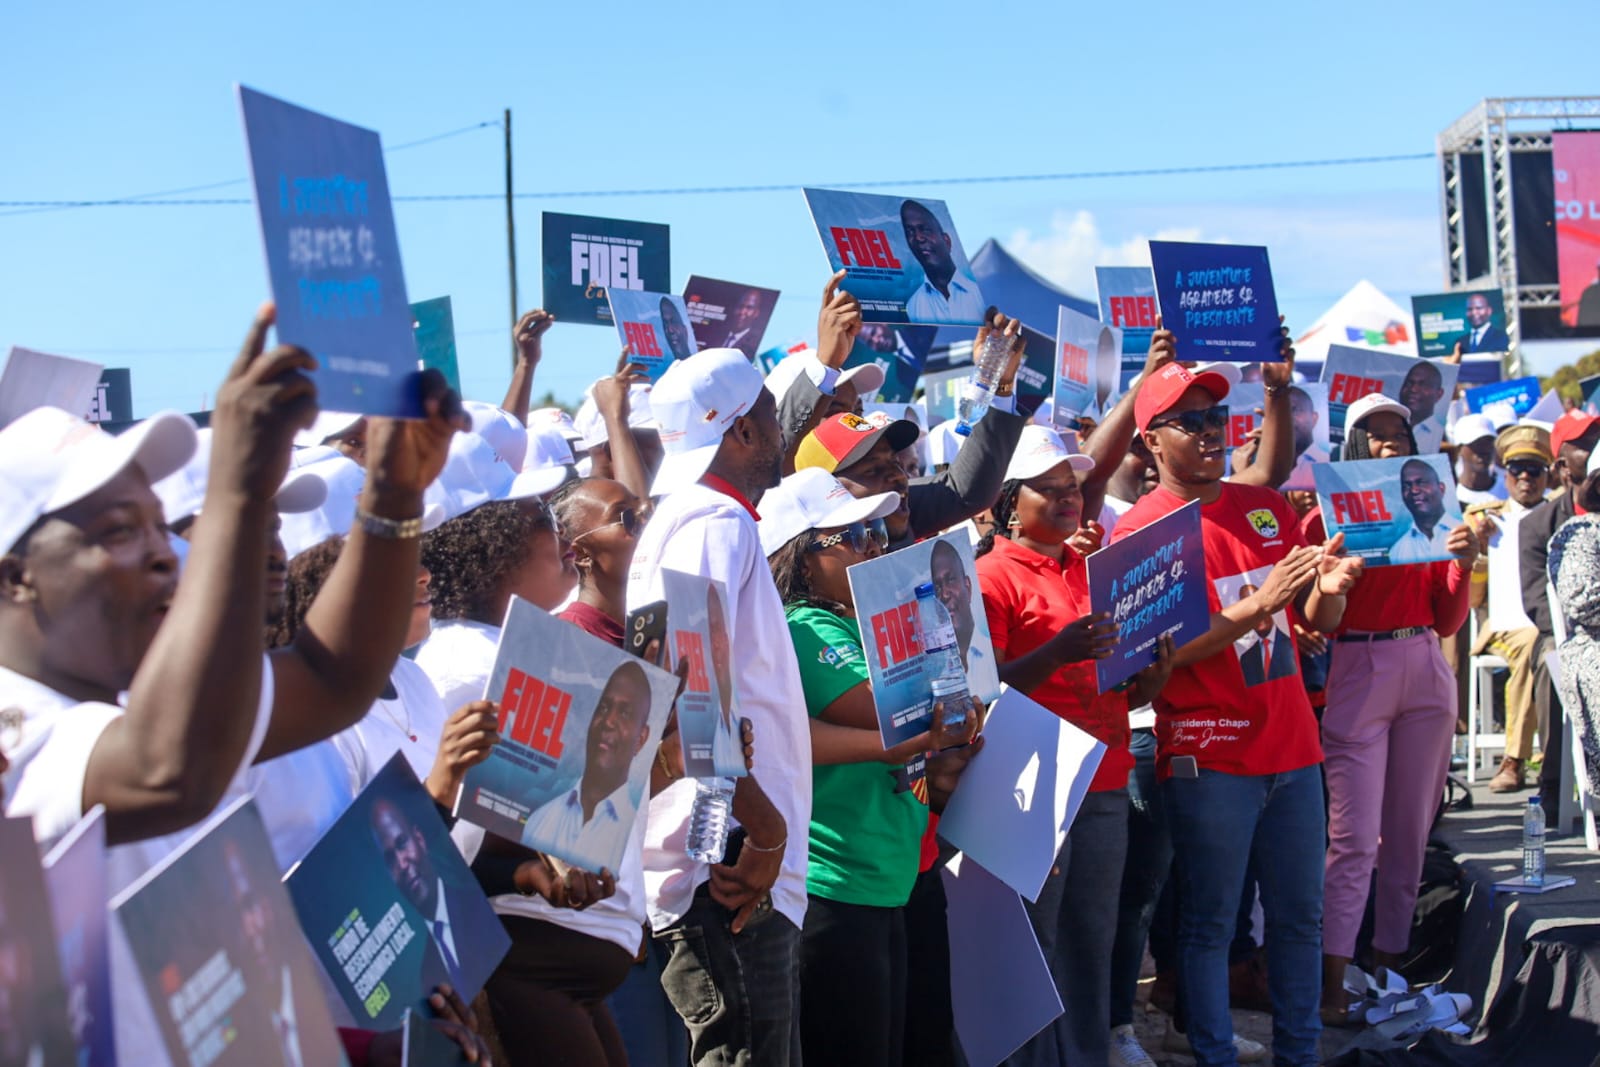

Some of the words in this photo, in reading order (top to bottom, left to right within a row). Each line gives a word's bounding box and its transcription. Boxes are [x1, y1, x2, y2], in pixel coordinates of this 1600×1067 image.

[571, 240, 644, 291] FDEL
[829, 226, 902, 269] FDEL
[1175, 270, 1183, 288] A
[1188, 266, 1252, 287] JUVENTUDE
[1179, 287, 1235, 310] AGRADECE
[1239, 285, 1258, 305] SR.
[623, 321, 664, 357] FDEL
[1185, 306, 1255, 329] PRESIDENTE
[1062, 342, 1088, 385] FDEL
[1330, 489, 1392, 524] FDEL
[1110, 579, 1118, 602] A
[1123, 535, 1184, 592] JUVENTUDE
[1113, 570, 1167, 623] AGRADECE
[1171, 560, 1187, 585] SR.
[1118, 582, 1184, 640] PRESIDENTE
[497, 667, 573, 760] FDEL
[1219, 718, 1250, 729] Chapo
[332, 928, 361, 966] FUNDO
[353, 915, 370, 939] DE
[343, 901, 406, 984] DESENVOLVIMENTO
[388, 920, 416, 955] LOCAL
